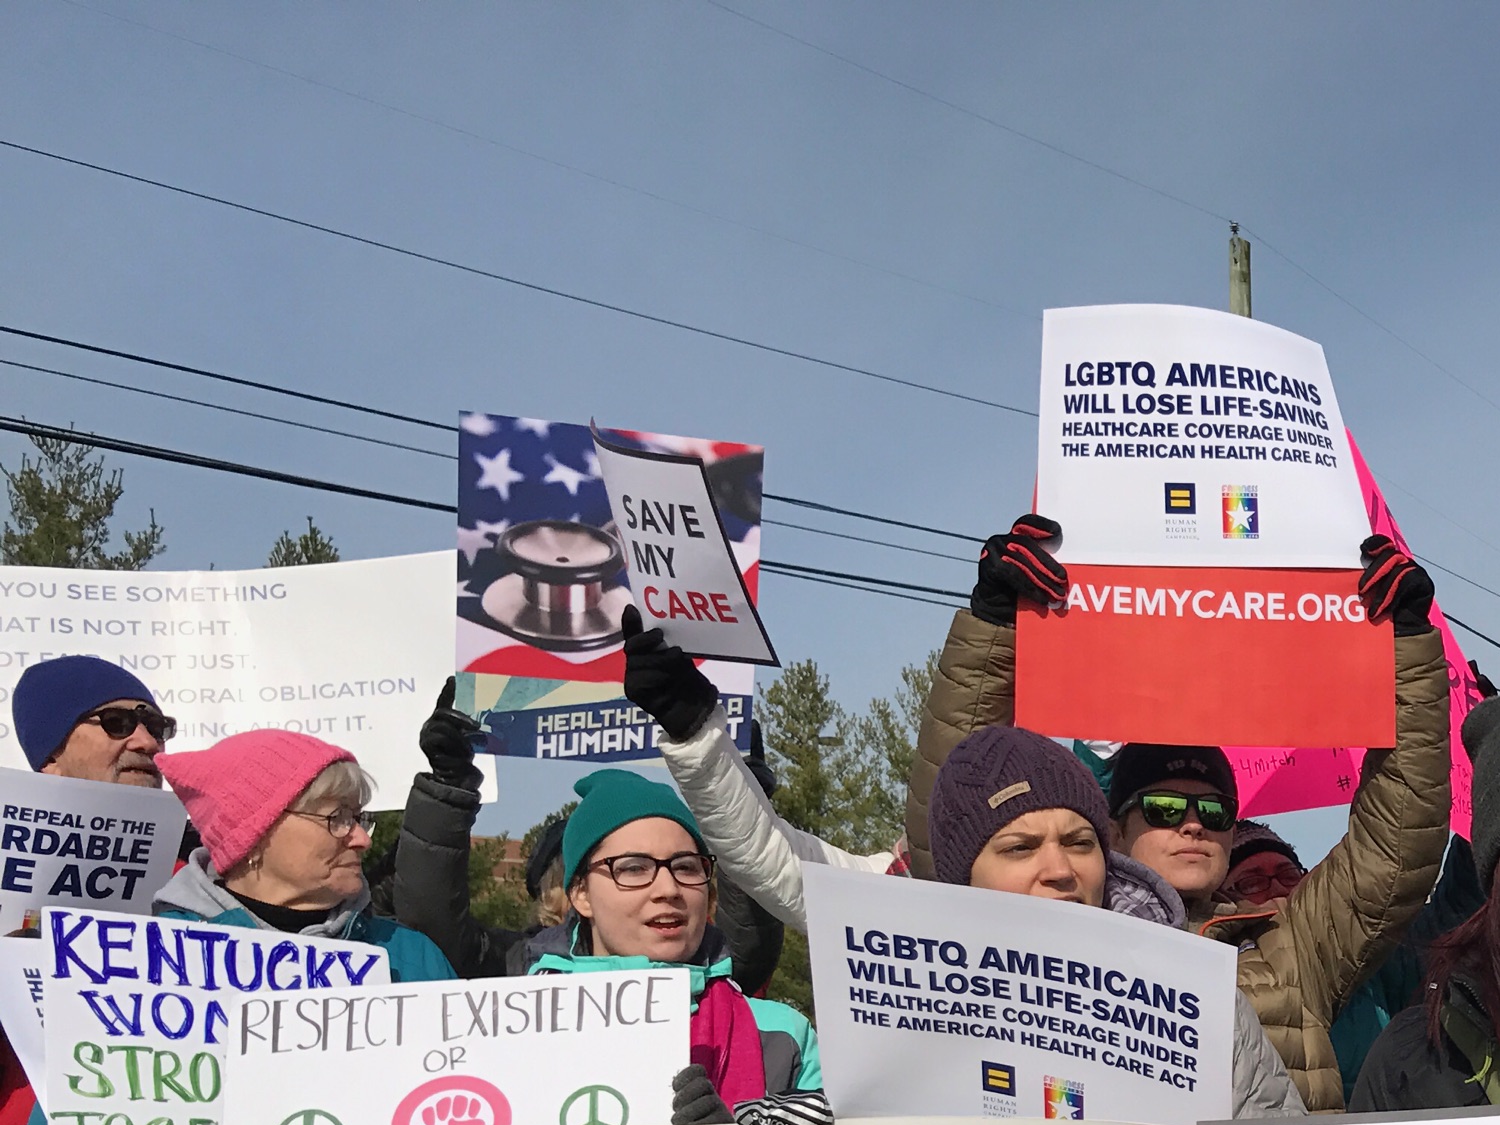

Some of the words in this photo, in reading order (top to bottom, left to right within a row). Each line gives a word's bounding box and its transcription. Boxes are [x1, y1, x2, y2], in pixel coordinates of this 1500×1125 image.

[1064, 362, 1156, 388] LGBTQ
[1165, 363, 1321, 406] AMERICANS
[1063, 394, 1115, 414] WILL
[1122, 394, 1192, 415] LOSE
[1200, 395, 1329, 431] LIFE-SAVING
[1062, 421, 1179, 438] HEALTHCARE
[1184, 422, 1284, 442] COVERAGE
[1287, 429, 1334, 451] UNDER
[1062, 443, 1089, 457] THE
[1094, 443, 1195, 459] AMERICAN
[1200, 444, 1267, 461] HEALTH
[1271, 447, 1312, 464] CARE
[1315, 453, 1338, 469] ACT
[622, 494, 705, 539] SAVE
[632, 540, 676, 578] MY
[0, 581, 57, 598] YOU
[67, 583, 117, 601] SEE
[126, 583, 287, 602] SOMETHING
[643, 585, 738, 623] CARE
[0, 616, 40, 633] AT
[51, 617, 73, 634] IS
[83, 619, 141, 636] NOT
[152, 620, 237, 636] RIGHT.
[119, 654, 176, 670] NOT
[187, 654, 256, 670] JUST.
[153, 687, 244, 704] MORAL
[259, 677, 416, 702] OBLIGATION
[345, 715, 372, 731] IT.
[536, 726, 645, 759] HUMAN
[3, 804, 85, 829] REPEAL
[90, 816, 117, 832] OF
[121, 820, 156, 836] THE
[1, 823, 153, 865] RDABLE
[1, 856, 36, 893] E
[48, 864, 146, 900] ACT
[50, 911, 380, 993] KENTUCKY
[845, 925, 969, 969] LGBTQ
[978, 945, 1201, 1020] AMERICANS
[240, 994, 419, 1056] RESPECT
[441, 976, 675, 1043] EXISTENCE
[847, 957, 922, 990] WILL
[928, 971, 1012, 1001] LOSE
[1020, 982, 1200, 1050] LIFE-SAVING
[849, 986, 996, 1020] HEALTHCARE
[1002, 1006, 1120, 1048] COVERAGE
[1125, 1036, 1198, 1072] UNDER
[423, 1046, 467, 1073] OR
[850, 1006, 891, 1029] THE
[896, 1014, 1015, 1042] AMERICAN
[1020, 1031, 1097, 1062] HEALTH
[1101, 1051, 1154, 1080] CARE
[1159, 1069, 1197, 1093] ACT
[983, 1096, 1017, 1106] HUMAN
[983, 1103, 1017, 1115] RIGHTS
